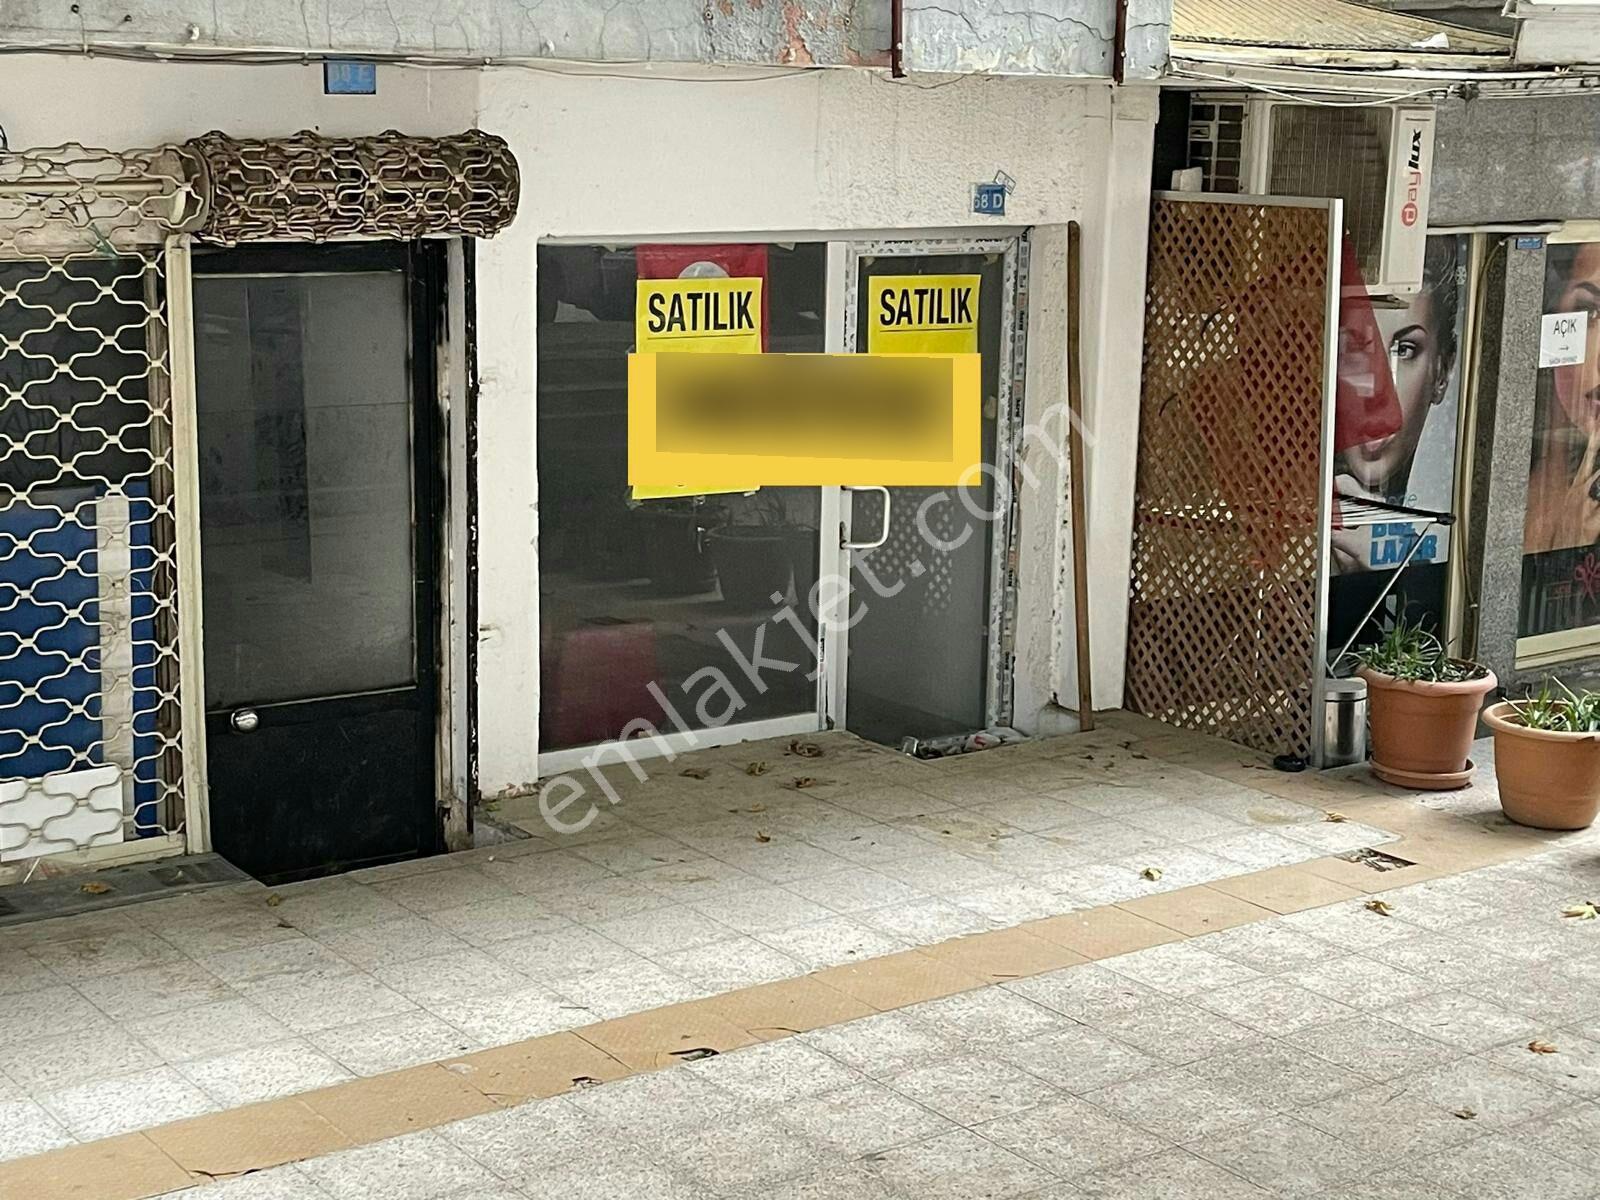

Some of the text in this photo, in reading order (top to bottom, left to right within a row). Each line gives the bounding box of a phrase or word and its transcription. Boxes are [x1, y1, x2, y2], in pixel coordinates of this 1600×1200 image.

[992, 194, 1003, 209] D
[648, 290, 755, 333] SATILIK
[880, 287, 973, 326] SATILIK
[1553, 318, 1577, 338] AÇIK
